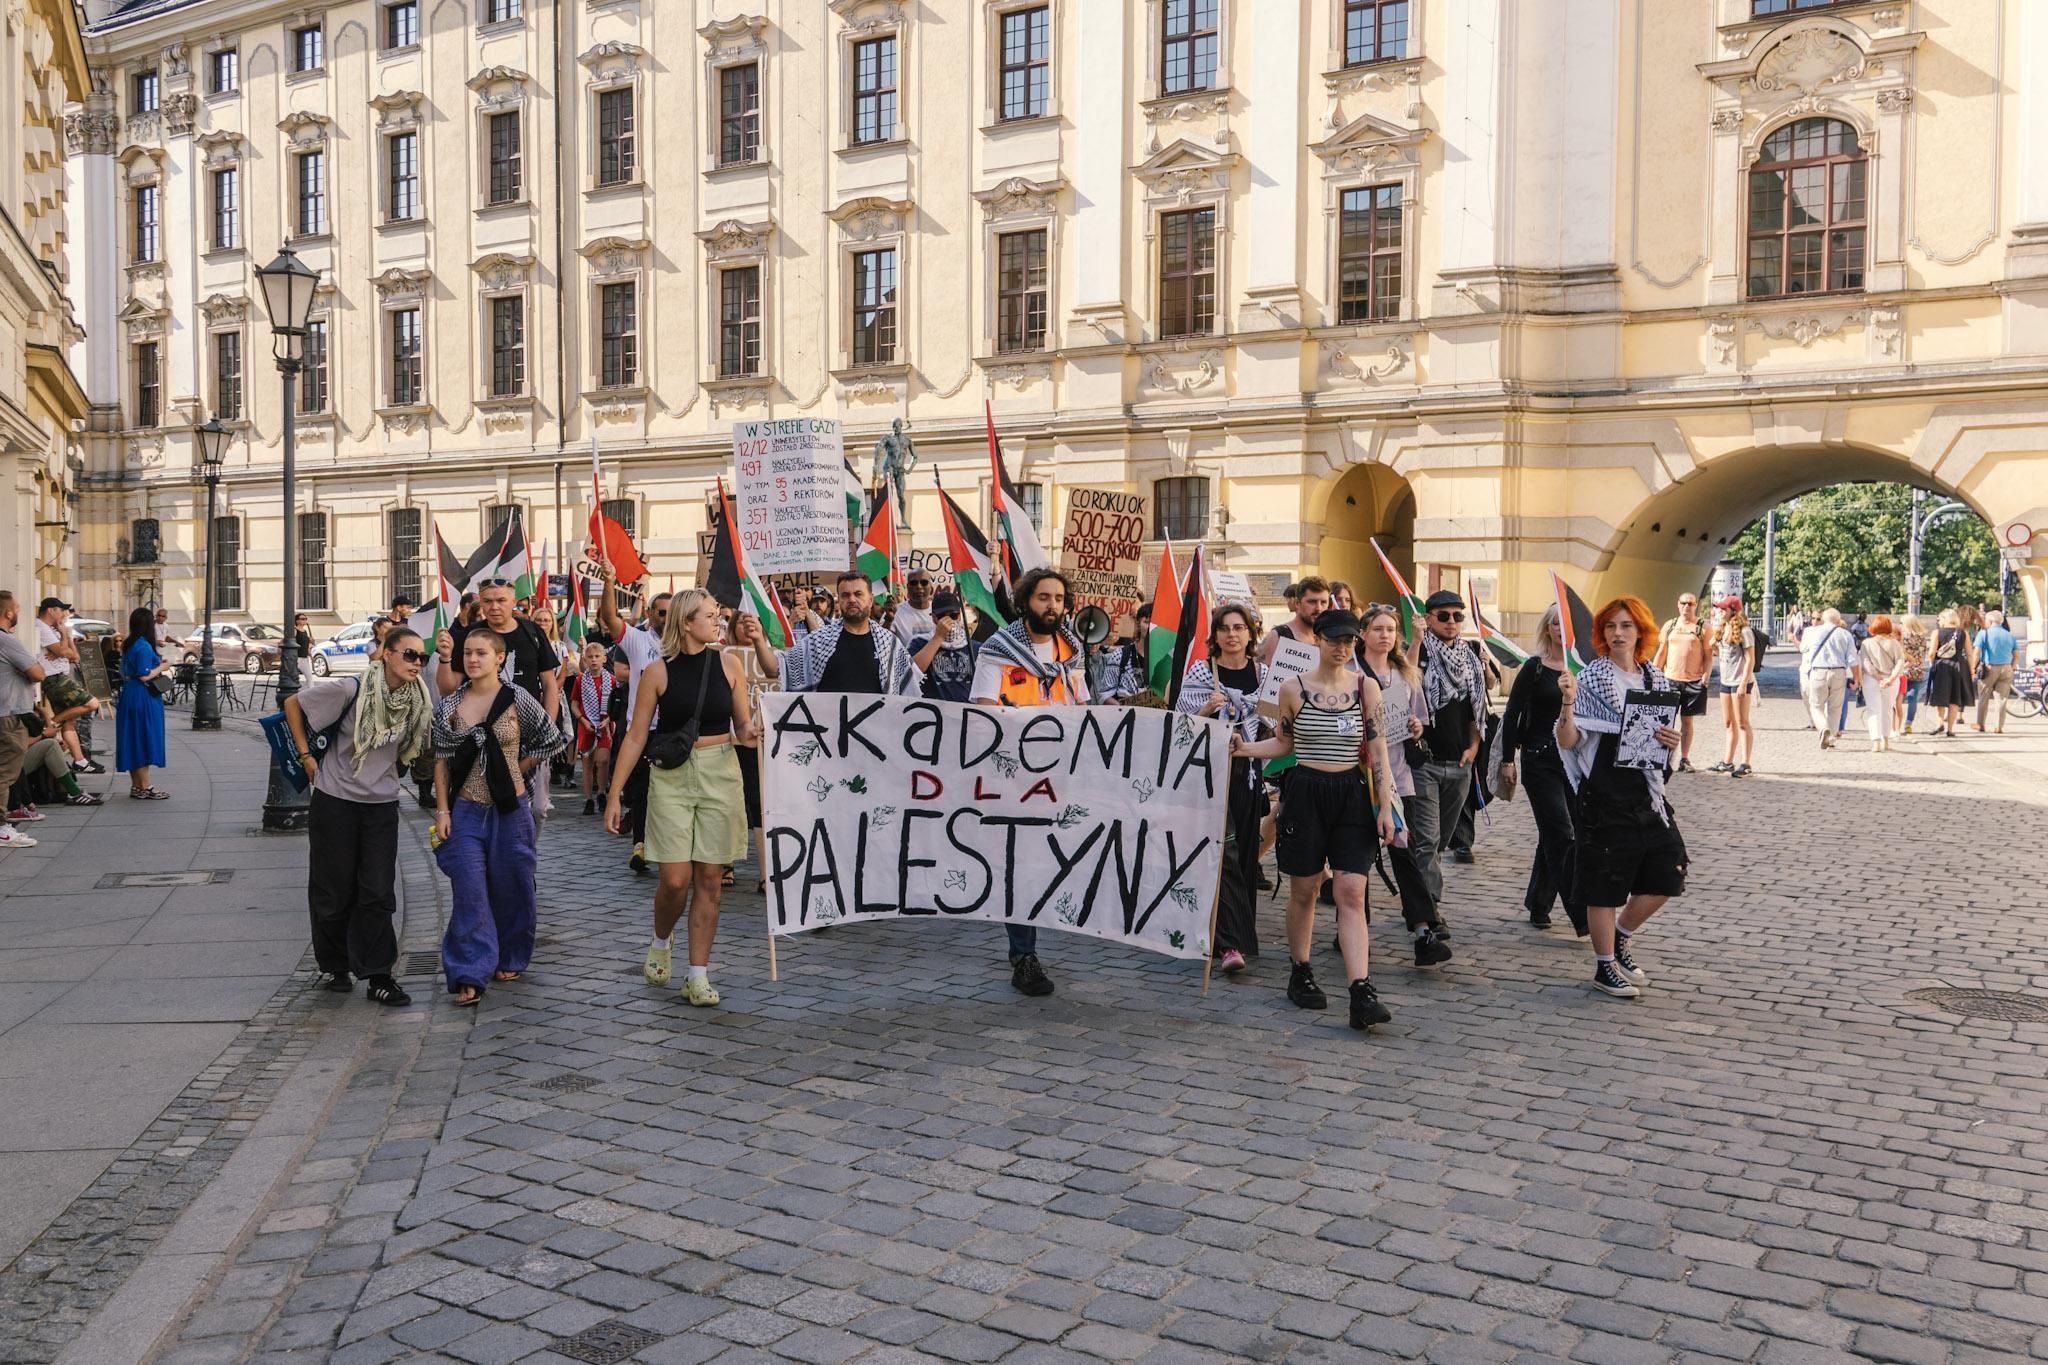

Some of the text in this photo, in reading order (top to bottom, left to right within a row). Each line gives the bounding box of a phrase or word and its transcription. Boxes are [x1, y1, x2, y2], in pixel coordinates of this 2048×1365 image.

[745, 420, 835, 437] W STREFIE GAZY
[738, 439, 768, 458] 12/12
[741, 461, 762, 476] 497
[756, 481, 770, 489] TYM
[775, 477, 788, 489] 95
[747, 489, 835, 504] ORAZ 3 REKTORÓW
[1071, 489, 1091, 508] CO
[1091, 491, 1127, 513] ROKU
[746, 508, 768, 525] 357
[810, 526, 845, 535] STUDENTÓW
[1069, 510, 1144, 544] 500-700
[743, 530, 773, 551] 9241
[1062, 536, 1142, 561] PALESTYŃSKICH
[763, 551, 781, 559] DANE
[1078, 555, 1116, 572] DZIECI
[1112, 584, 1138, 598] PRZEZ
[1285, 648, 1312, 661] IZRAEL
[1637, 704, 1665, 716] RESIST
[911, 770, 1057, 803] DLA
[766, 807, 1210, 934] PALESTYNY
